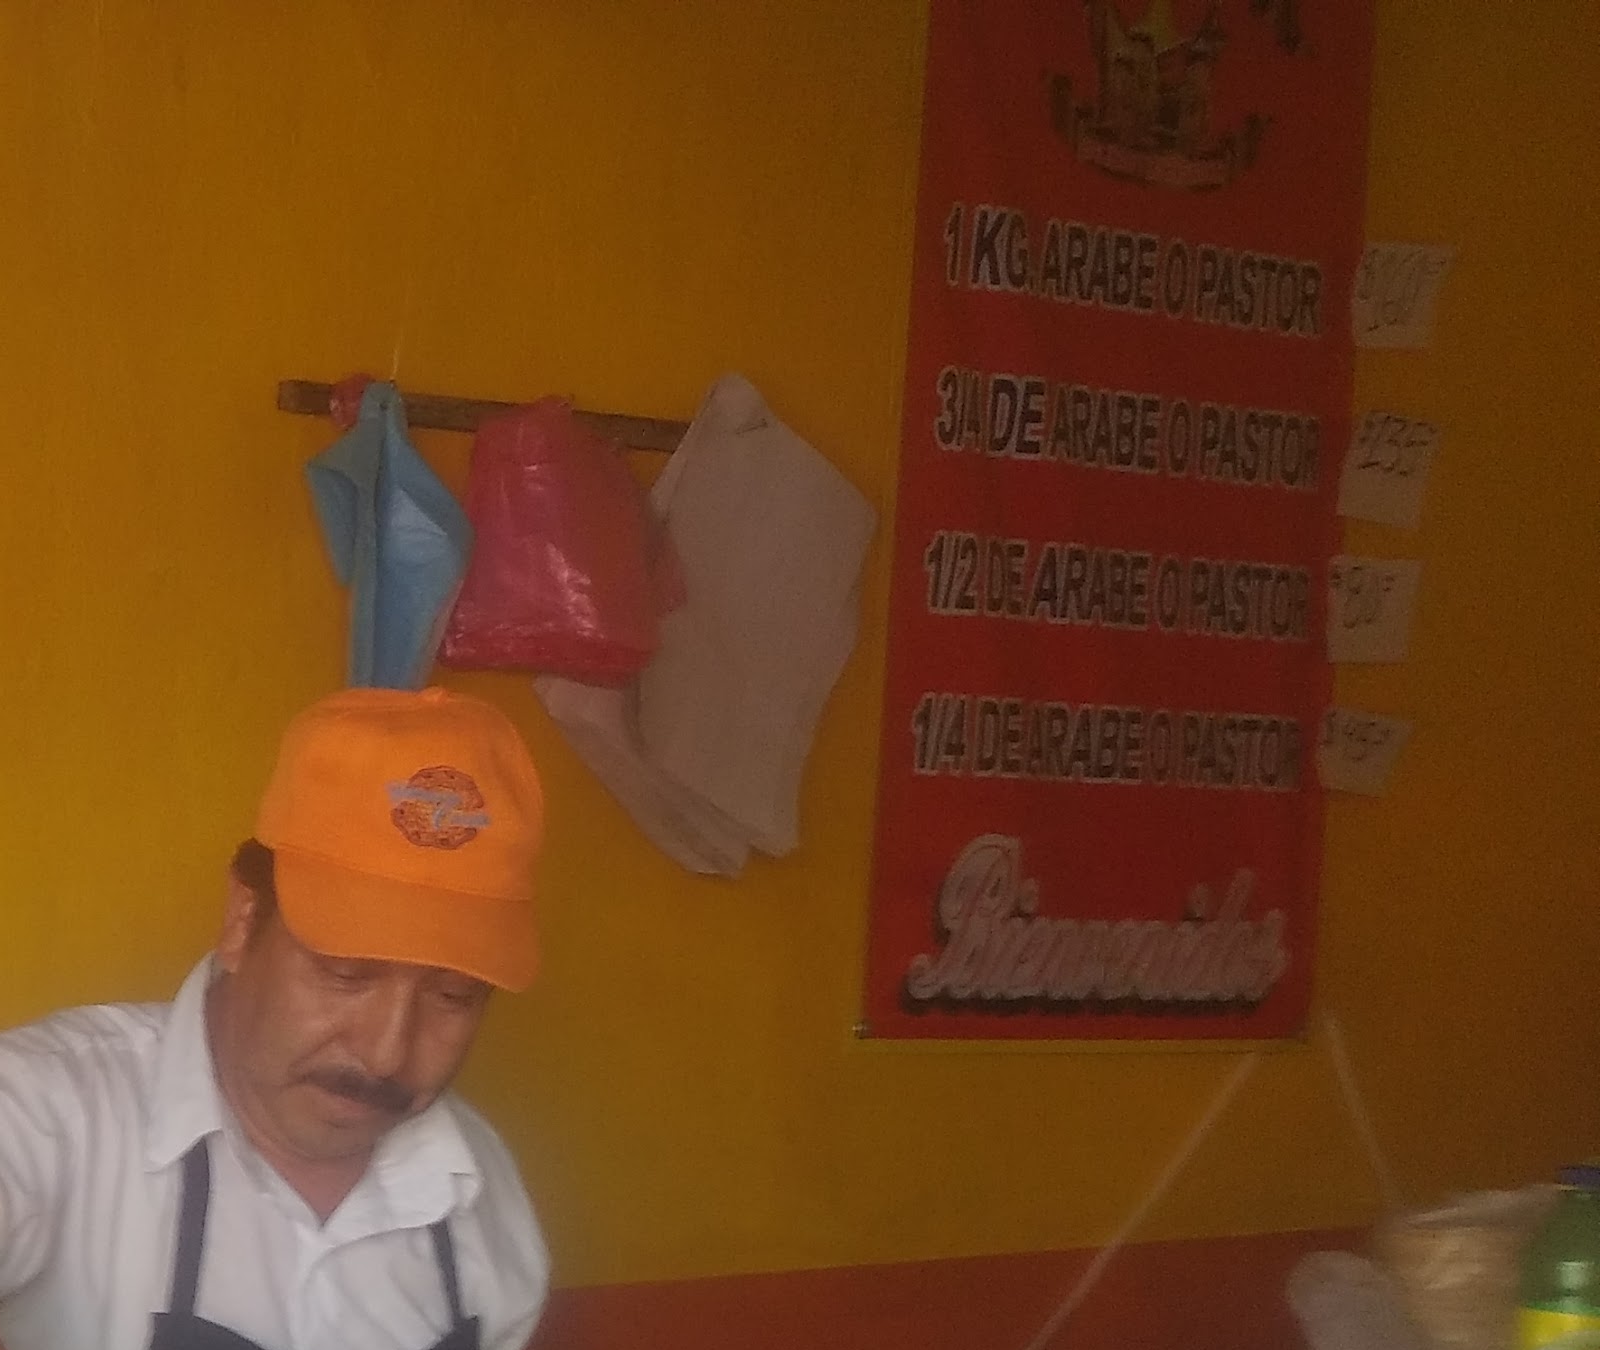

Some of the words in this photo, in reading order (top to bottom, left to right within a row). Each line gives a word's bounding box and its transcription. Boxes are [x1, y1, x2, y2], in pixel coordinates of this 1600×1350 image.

[943, 201, 965, 286] 1
[1040, 218, 1158, 314] ARABE
[1164, 238, 1189, 319] O
[1195, 245, 1322, 338] PASTOR
[936, 365, 984, 451] 3/4
[987, 372, 1046, 457] DE
[1049, 384, 1160, 474] ARABE
[1167, 401, 1191, 476] O
[1197, 403, 1320, 491] PASTOR
[925, 530, 981, 614] 1/2
[983, 535, 1028, 617] DE
[1029, 541, 1150, 630] ARABE
[1156, 554, 1183, 633] O
[1189, 558, 1312, 641] PASTOR
[913, 692, 970, 775] 1/4
[973, 695, 1023, 776] DE
[1025, 700, 1146, 785] ARABE
[1147, 708, 1174, 785] O
[1179, 711, 1303, 791] PASTOR
